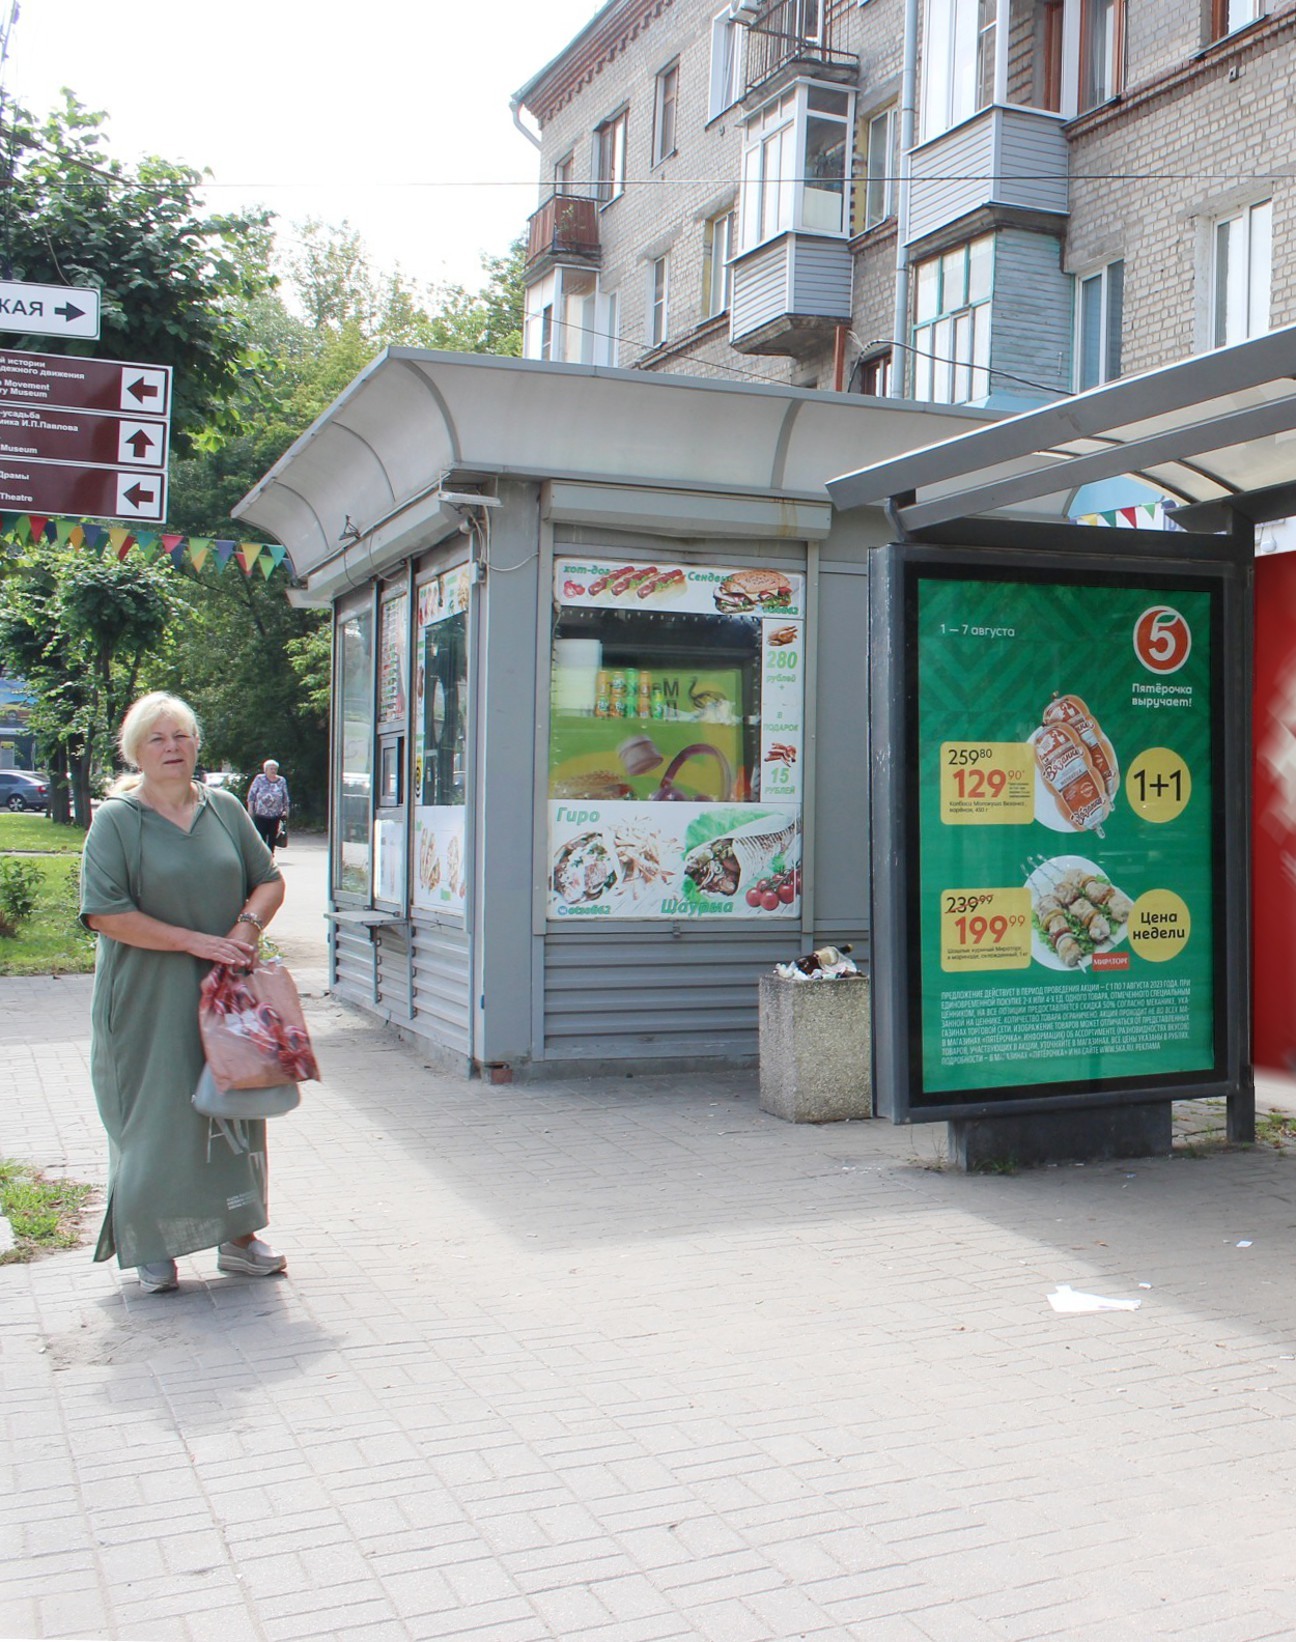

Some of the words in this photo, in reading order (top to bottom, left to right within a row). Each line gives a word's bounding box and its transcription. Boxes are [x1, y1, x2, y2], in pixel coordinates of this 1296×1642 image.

[0, 298, 43, 317] КАЯ
[8, 358, 46, 368] истории
[40, 370, 84, 380] движения
[4, 379, 50, 391] Movement
[10, 388, 48, 398] Museum
[0, 444, 38, 454] Museum
[0, 492, 33, 502] Theatre
[962, 624, 969, 635] 7
[971, 626, 1015, 638] августа
[766, 651, 798, 670] 280
[1132, 682, 1192, 696] Пятёрочка
[1132, 696, 1192, 708] выручает!
[771, 768, 790, 784] 15
[1133, 769, 1182, 801] 1+1
[556, 806, 600, 826] Гиро
[660, 898, 734, 916] Шаурма
[1140, 911, 1178, 926] Цена
[1132, 927, 1185, 940] недели
